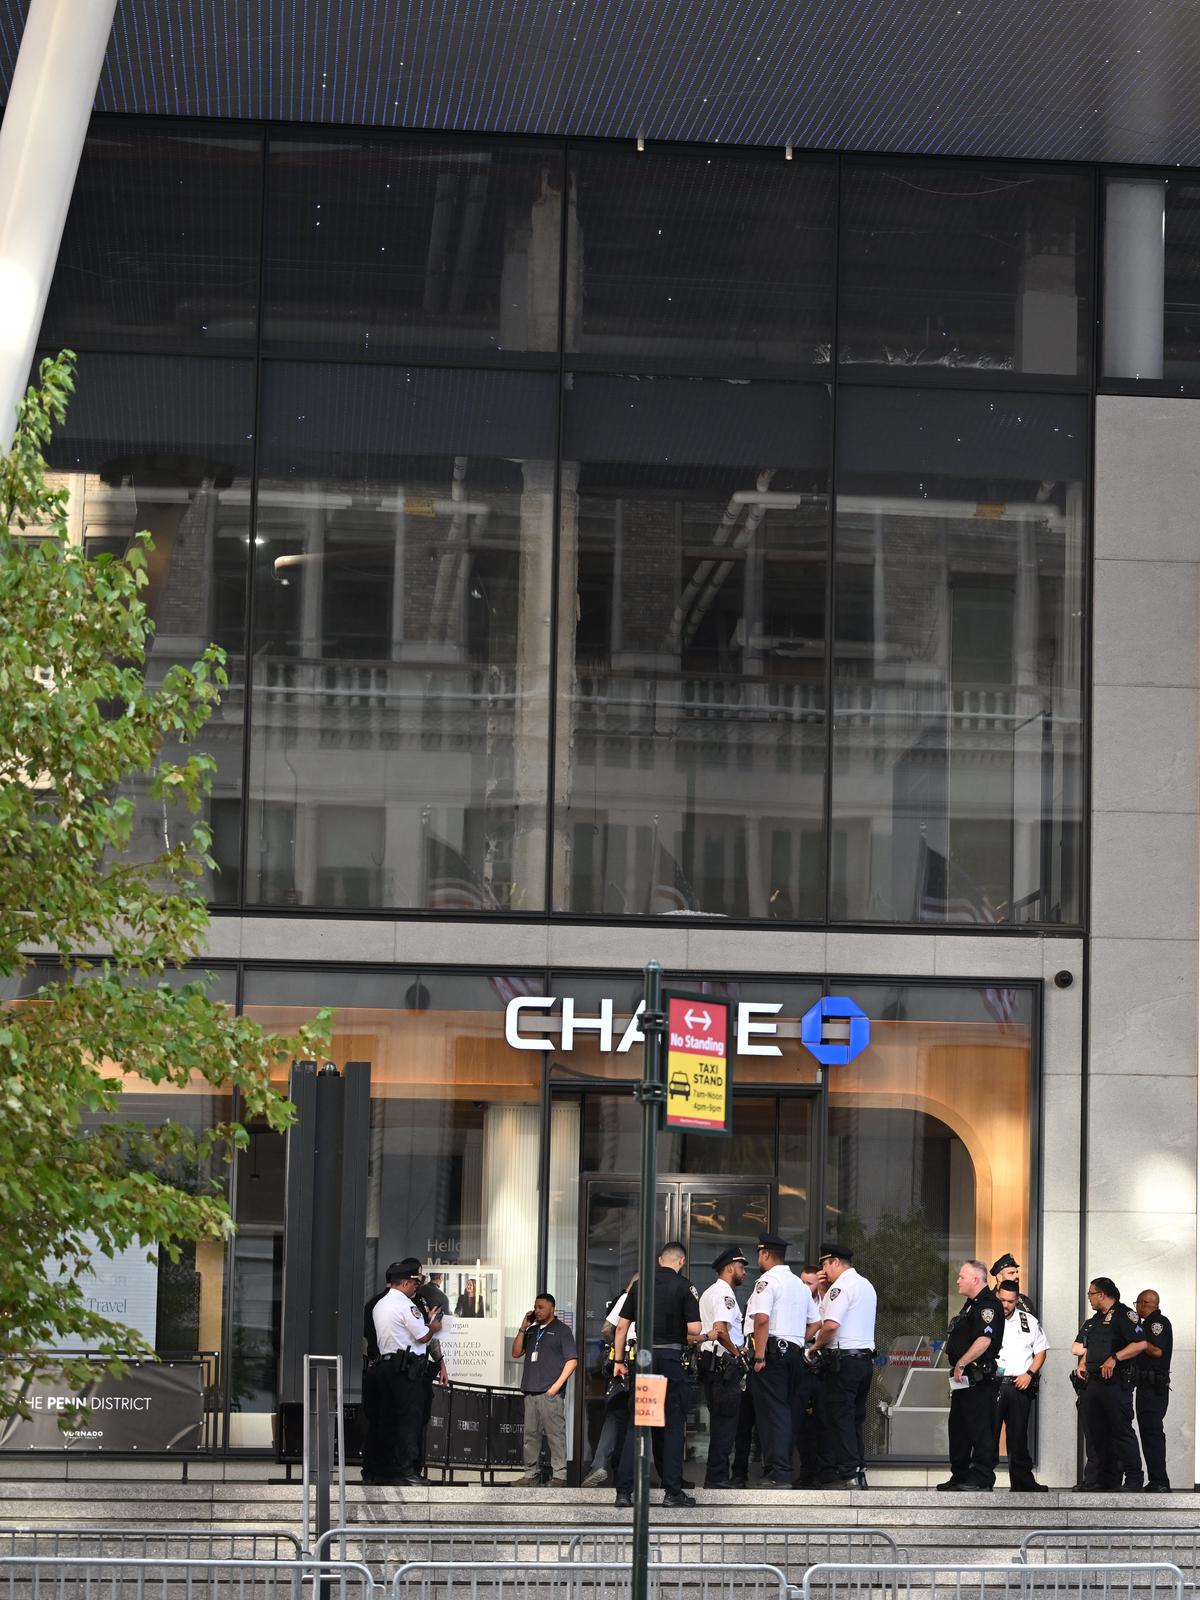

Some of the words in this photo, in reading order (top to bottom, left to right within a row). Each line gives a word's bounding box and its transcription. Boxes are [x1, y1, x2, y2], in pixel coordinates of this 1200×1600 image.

[505, 996, 784, 1058] CHAE
[670, 1032, 684, 1047] No
[685, 1035, 724, 1056] Standing
[698, 1062, 719, 1075] TAXI
[693, 1073, 723, 1087] STAND
[87, 1298, 127, 1313] Travel
[91, 1397, 152, 1411] DISTRICT
